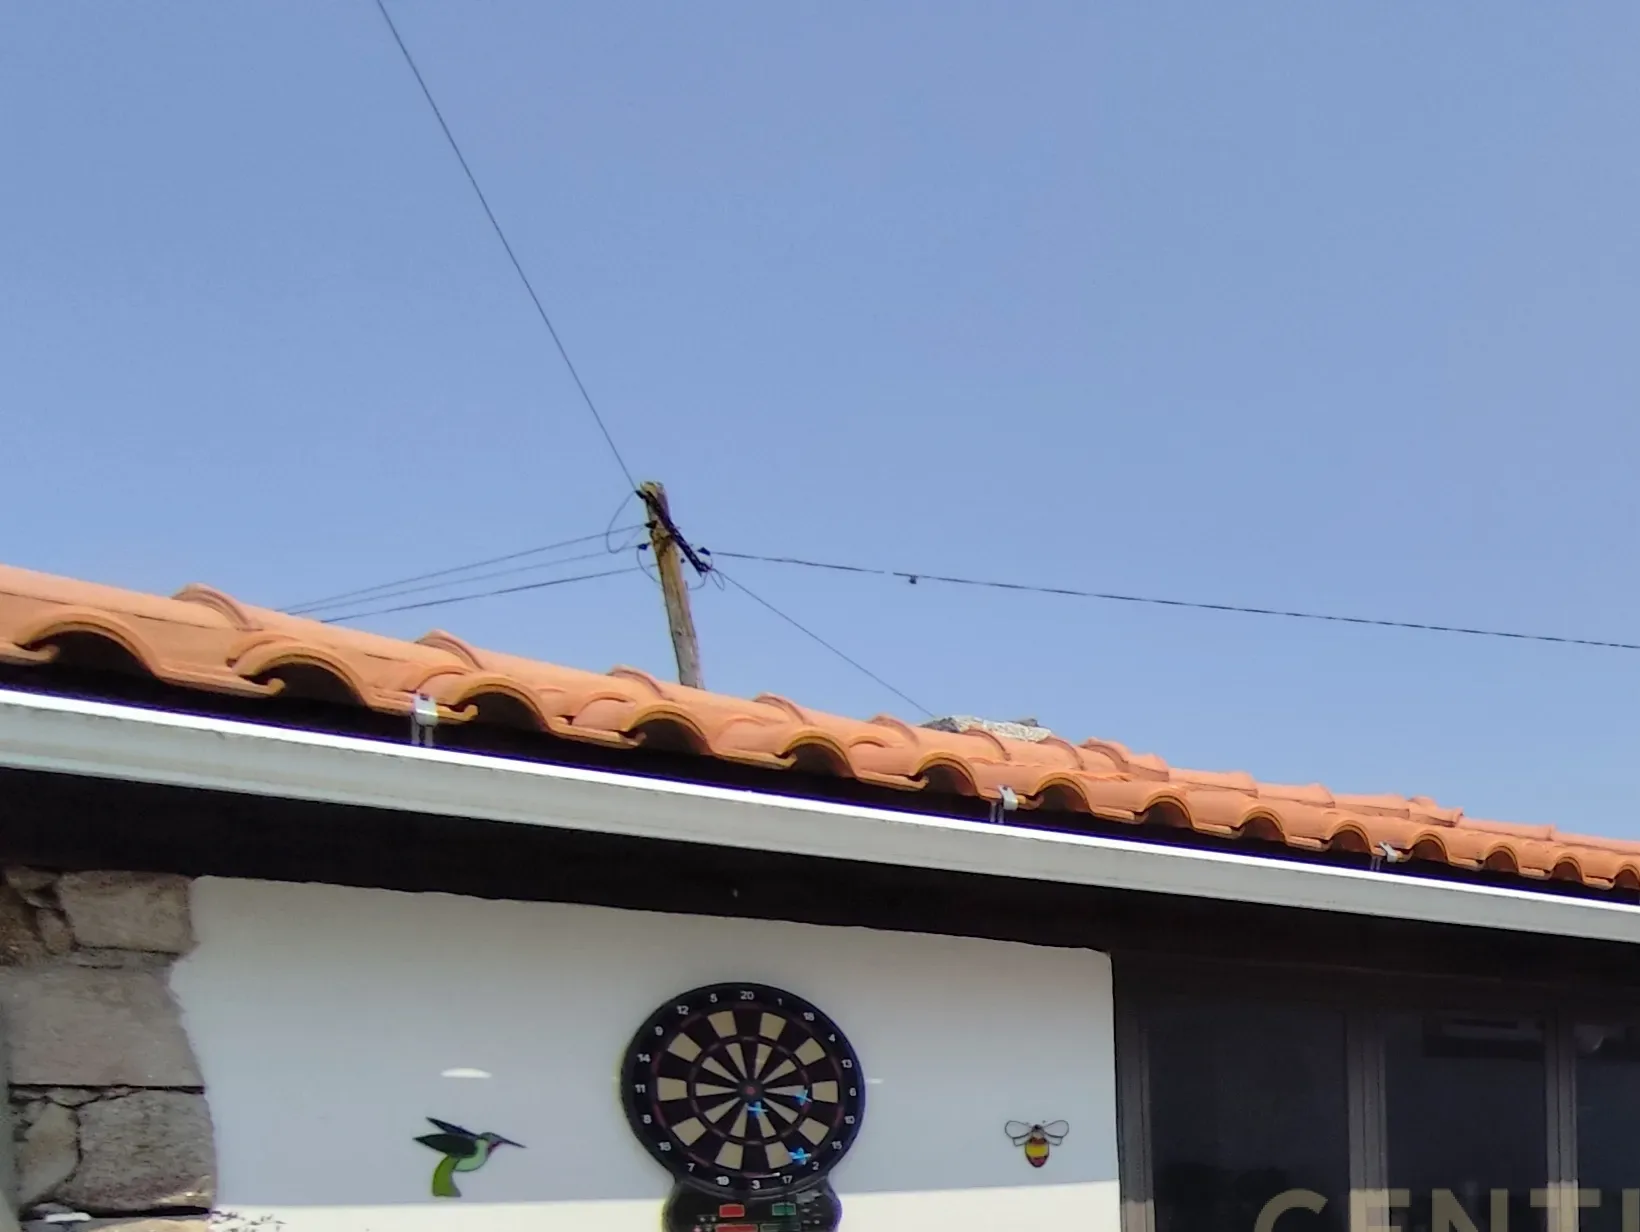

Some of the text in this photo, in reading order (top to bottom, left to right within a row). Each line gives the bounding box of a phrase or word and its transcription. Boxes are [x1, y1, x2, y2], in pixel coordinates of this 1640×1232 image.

[741, 991, 754, 1000] 20
[676, 1005, 689, 1015] 12
[829, 1034, 836, 1042] 4
[638, 1054, 650, 1062] 14
[635, 1084, 645, 1092] 11
[850, 1088, 857, 1097] 6
[831, 1141, 842, 1150] 15
[688, 1163, 695, 1171] 7
[812, 1162, 820, 1170] 2
[782, 1175, 792, 1184] 17
[752, 1180, 761, 1189] 3
